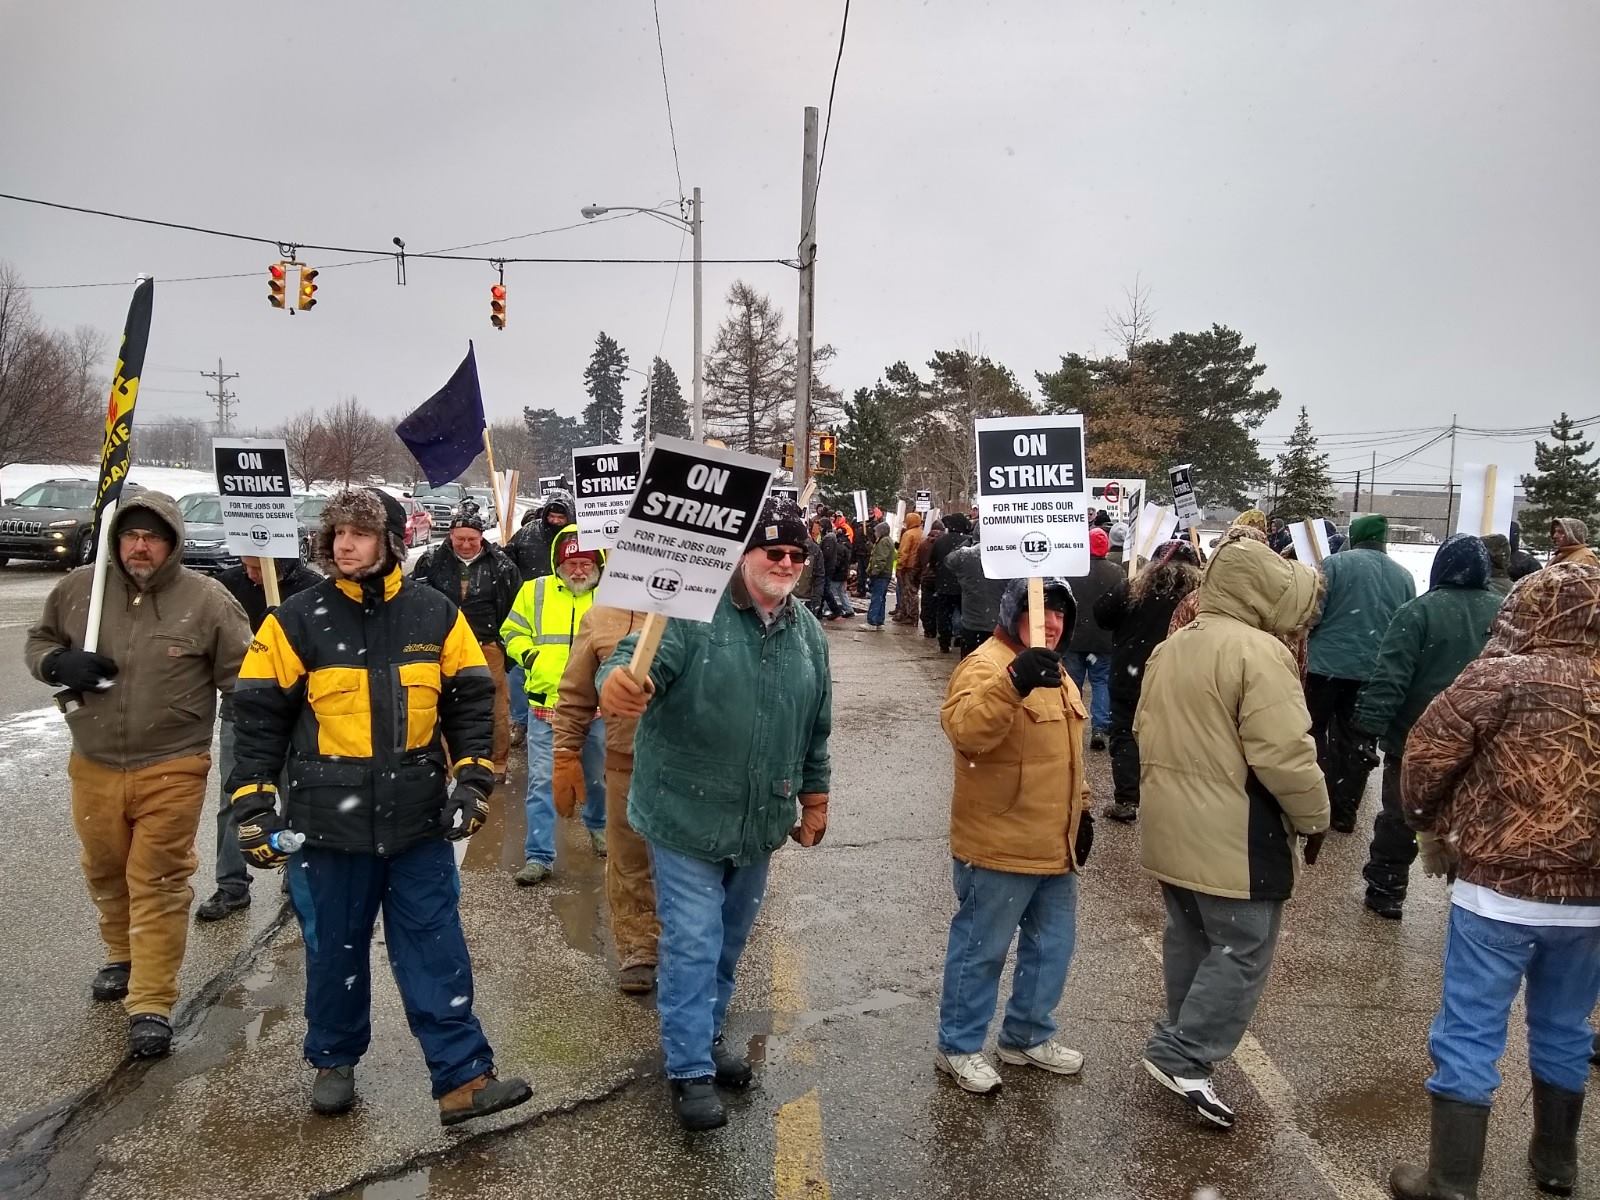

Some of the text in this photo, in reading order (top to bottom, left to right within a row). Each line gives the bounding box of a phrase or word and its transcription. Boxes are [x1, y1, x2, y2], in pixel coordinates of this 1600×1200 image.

[1013, 434, 1047, 457] ON
[237, 452, 263, 470] ON
[596, 456, 619, 473] ON
[223, 475, 285, 492] STRIKE
[581, 475, 637, 494] STRIKE
[686, 464, 731, 496] ON
[989, 464, 1075, 489] STRIKE
[223, 511, 264, 519] COMMUNITIES
[577, 509, 618, 517] COMMUNITIES
[642, 491, 746, 534] STRIKE
[992, 501, 1074, 512] FOR THE JOBS OUR
[982, 513, 1085, 525] COMMUNITIES DESERVE
[633, 529, 727, 557] FOR THE JOBS OUR
[616, 540, 733, 572] COMMUNITIES DESERVE
[609, 570, 630, 580] LOCAL
[684, 583, 704, 593] LOCAL
